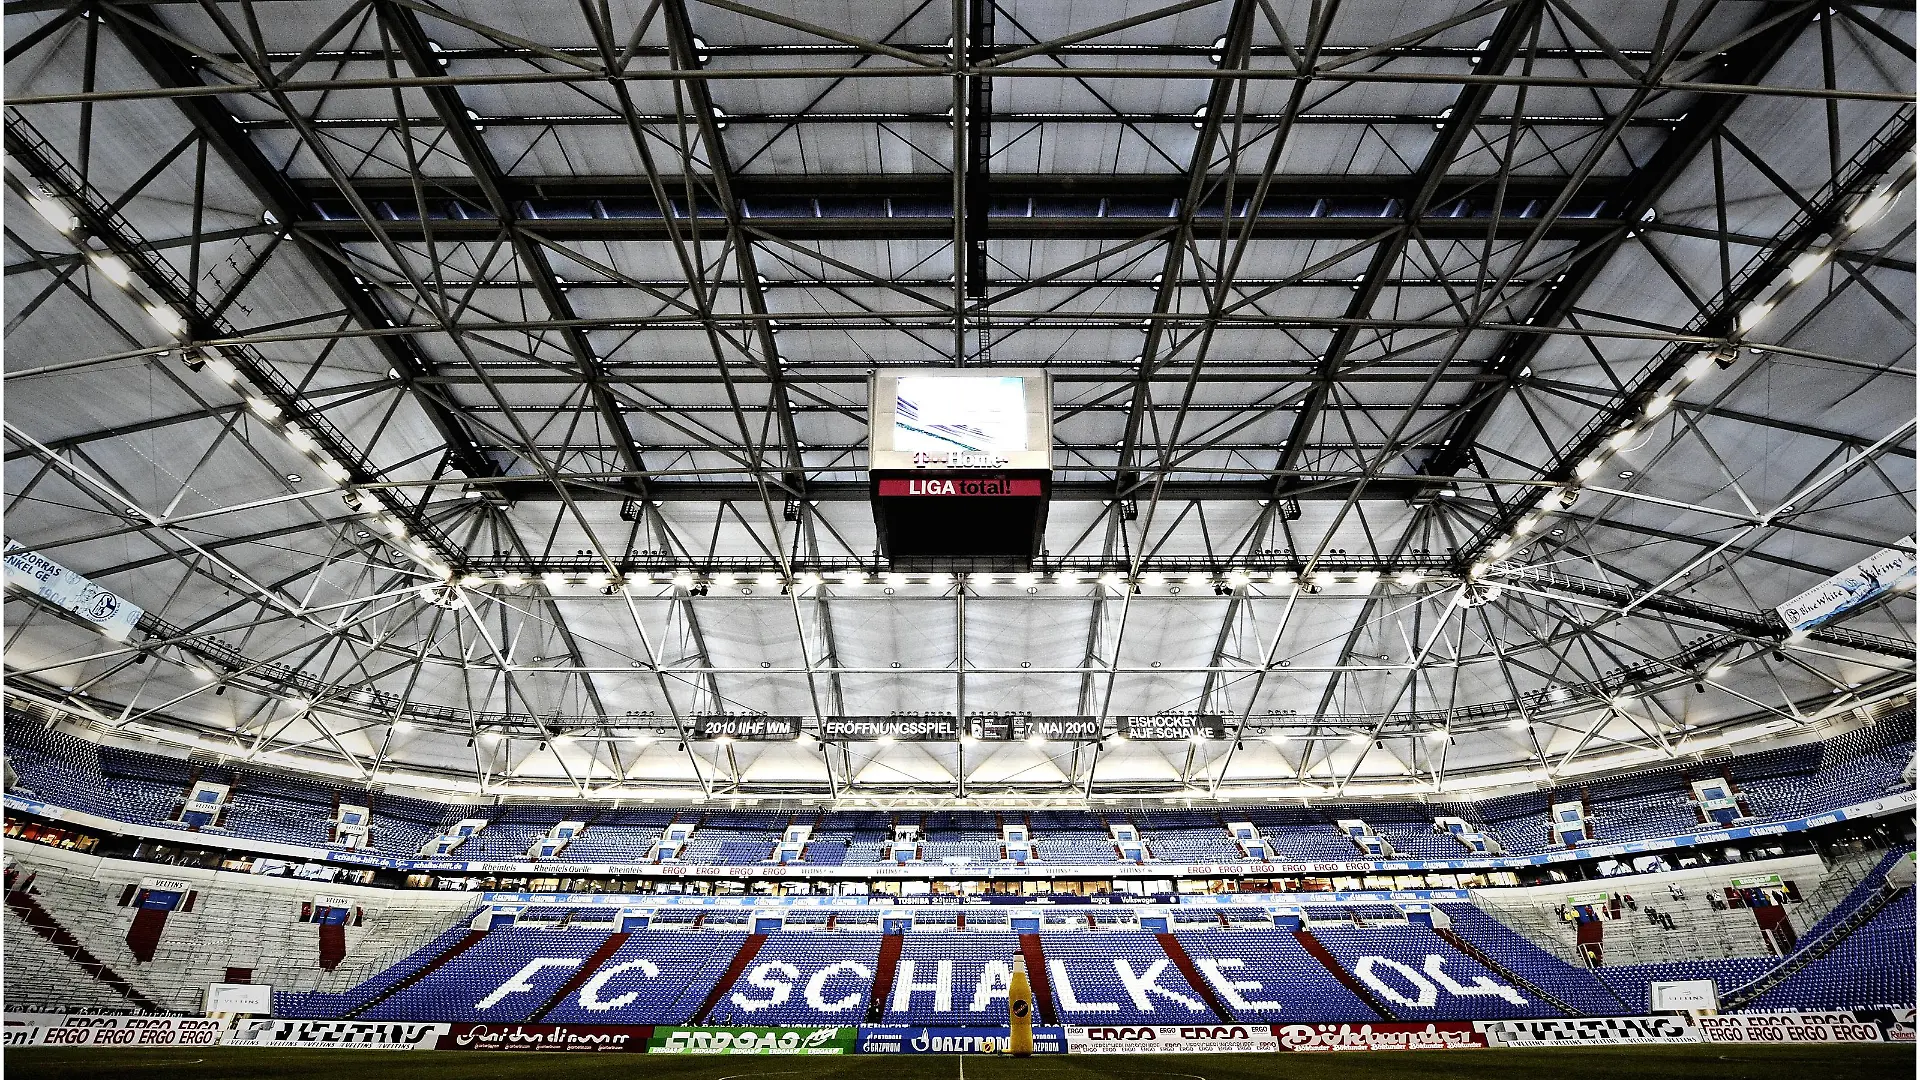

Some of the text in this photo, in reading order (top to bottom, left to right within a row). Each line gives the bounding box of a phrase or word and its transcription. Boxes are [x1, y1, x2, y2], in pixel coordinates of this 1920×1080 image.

[909, 479, 1011, 495] LIGA total!
[35, 569, 51, 582] GE
[826, 721, 955, 734] ERÖFFNUNGSSPIEL
[1026, 722, 1037, 734] 7.
[1038, 722, 1063, 734] MAI
[1065, 721, 1096, 734] 2010
[1128, 716, 1197, 727] EISHOCKEY
[705, 722, 791, 734] 2010 IIHF WM
[1129, 727, 1214, 739] AUF SCHALKE
[662, 867, 786, 876] ERGO ERGO ERGO ERGO
[1187, 862, 1370, 874] ERGO ERGO ERGO ERGO ERGO ERGO
[156, 880, 184, 889] VELTINS
[326, 897, 348, 905] VELTINS
[898, 897, 930, 905] TOSHIBA
[1121, 896, 1157, 905] Volkswagen
[473, 953, 1530, 1013] FC SCHALKE 04
[43, 1027, 213, 1045] ERGO ERGO ERGO ERGO
[1709, 1023, 1878, 1041] ERGO ERGO ERGO ERGO
[870, 1042, 901, 1052] GAZPROM
[1033, 1042, 1060, 1052] AZPROM
